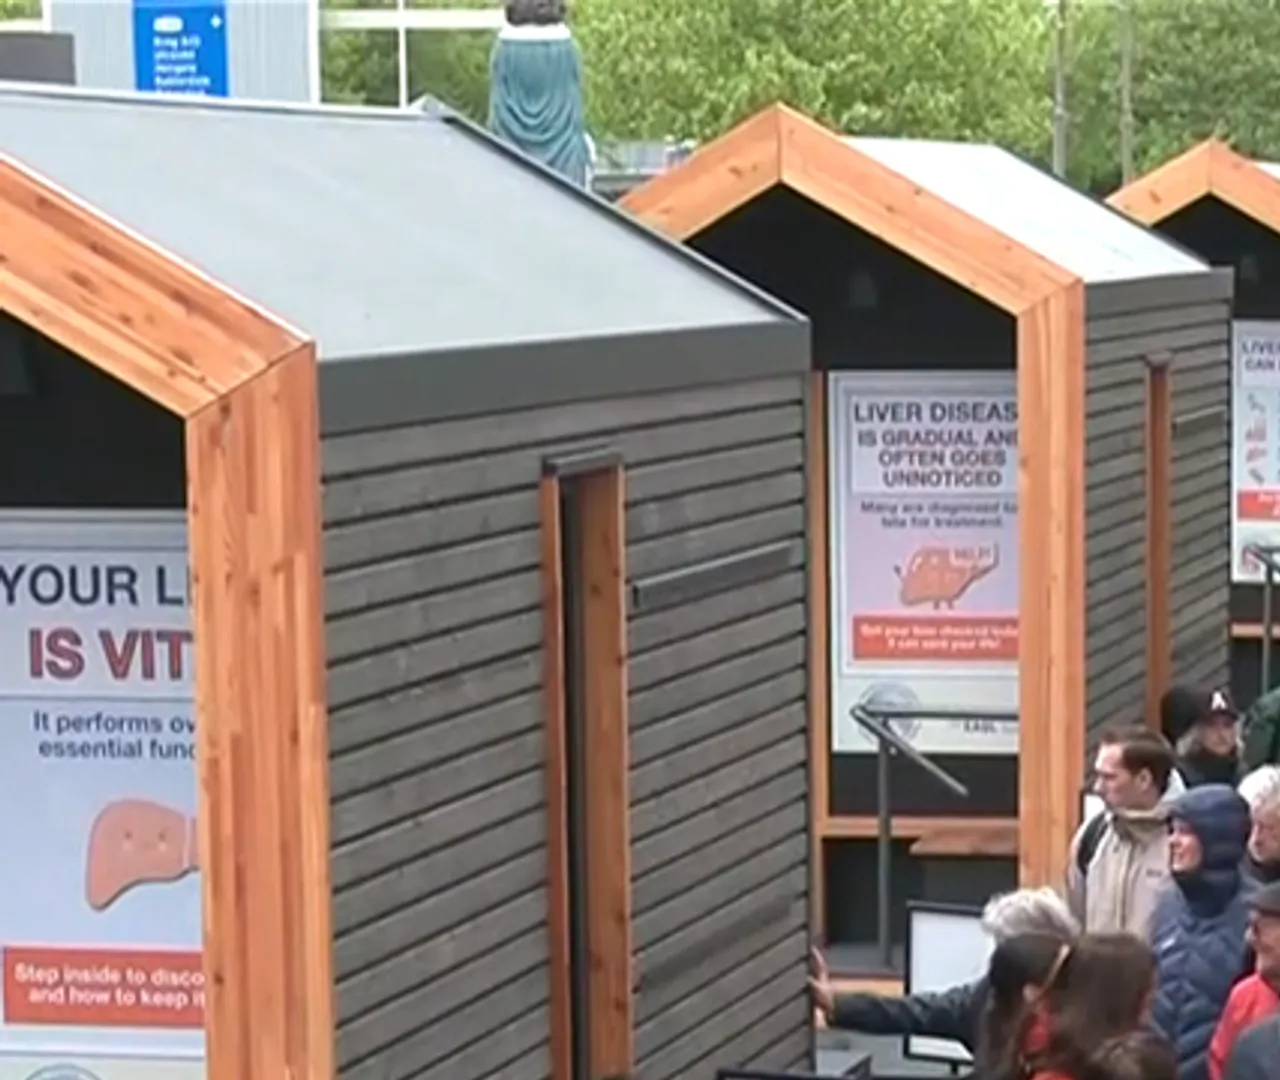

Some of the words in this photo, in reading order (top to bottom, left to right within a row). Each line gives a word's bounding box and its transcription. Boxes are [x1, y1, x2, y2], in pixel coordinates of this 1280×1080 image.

[1245, 358, 1275, 371] CAN
[853, 402, 923, 423] LIVER
[857, 430, 877, 447] IS
[882, 429, 977, 447] GRADUAL
[878, 450, 945, 467] OFTEN
[950, 450, 1007, 467] GOES
[882, 470, 1003, 488] UNNOTICED
[860, 501, 898, 515] Many
[902, 502, 924, 513] are
[928, 501, 1000, 515] diagnosed
[0, 564, 138, 606] YOUR
[28, 627, 85, 682] IS
[98, 629, 194, 682] VIT
[1210, 691, 1227, 710] A
[33, 711, 50, 730] It
[56, 711, 163, 736] performs
[38, 739, 142, 759] essential
[14, 962, 59, 986] Step
[63, 964, 121, 985] inside
[125, 966, 146, 986] to
[150, 967, 206, 987] disco
[27, 986, 64, 1004] and
[69, 986, 111, 1005] how
[115, 988, 136, 1006] to
[140, 990, 188, 1010] keep
